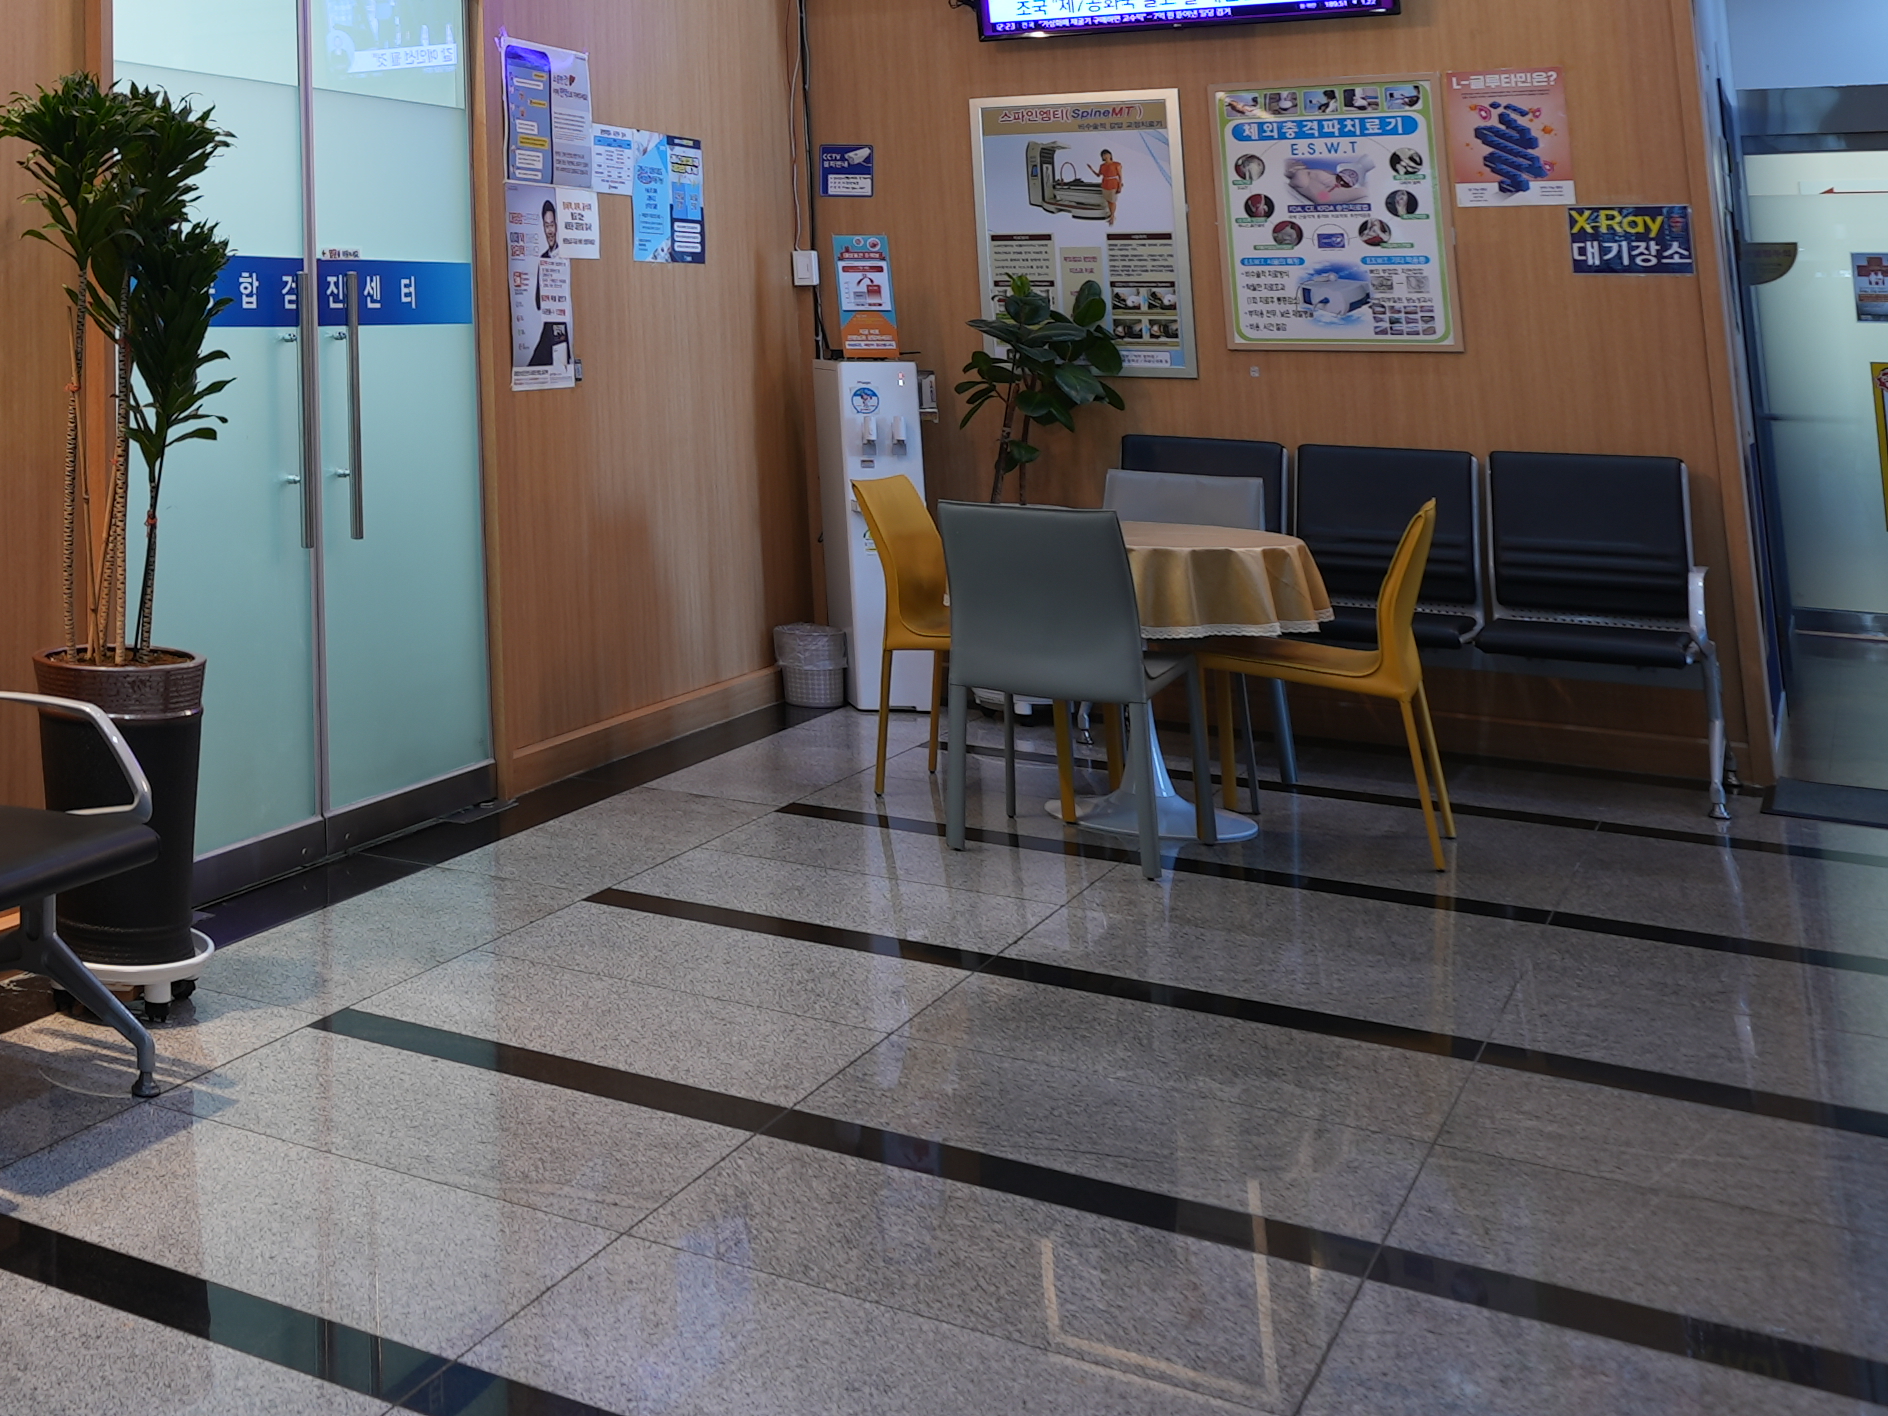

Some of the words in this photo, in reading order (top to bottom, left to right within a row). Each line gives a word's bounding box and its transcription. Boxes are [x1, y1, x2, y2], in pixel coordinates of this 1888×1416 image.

[1016, 0, 1048, 16] 조국
[1452, 71, 1557, 89] L-글루타민은?
[1242, 118, 1404, 140] 체외충격파치료기
[1291, 141, 1358, 156] E.S.W.T
[1569, 210, 1664, 237] X-Ray
[1572, 241, 1692, 266] 대기장소
[209, 272, 417, 309] 합검진센터
